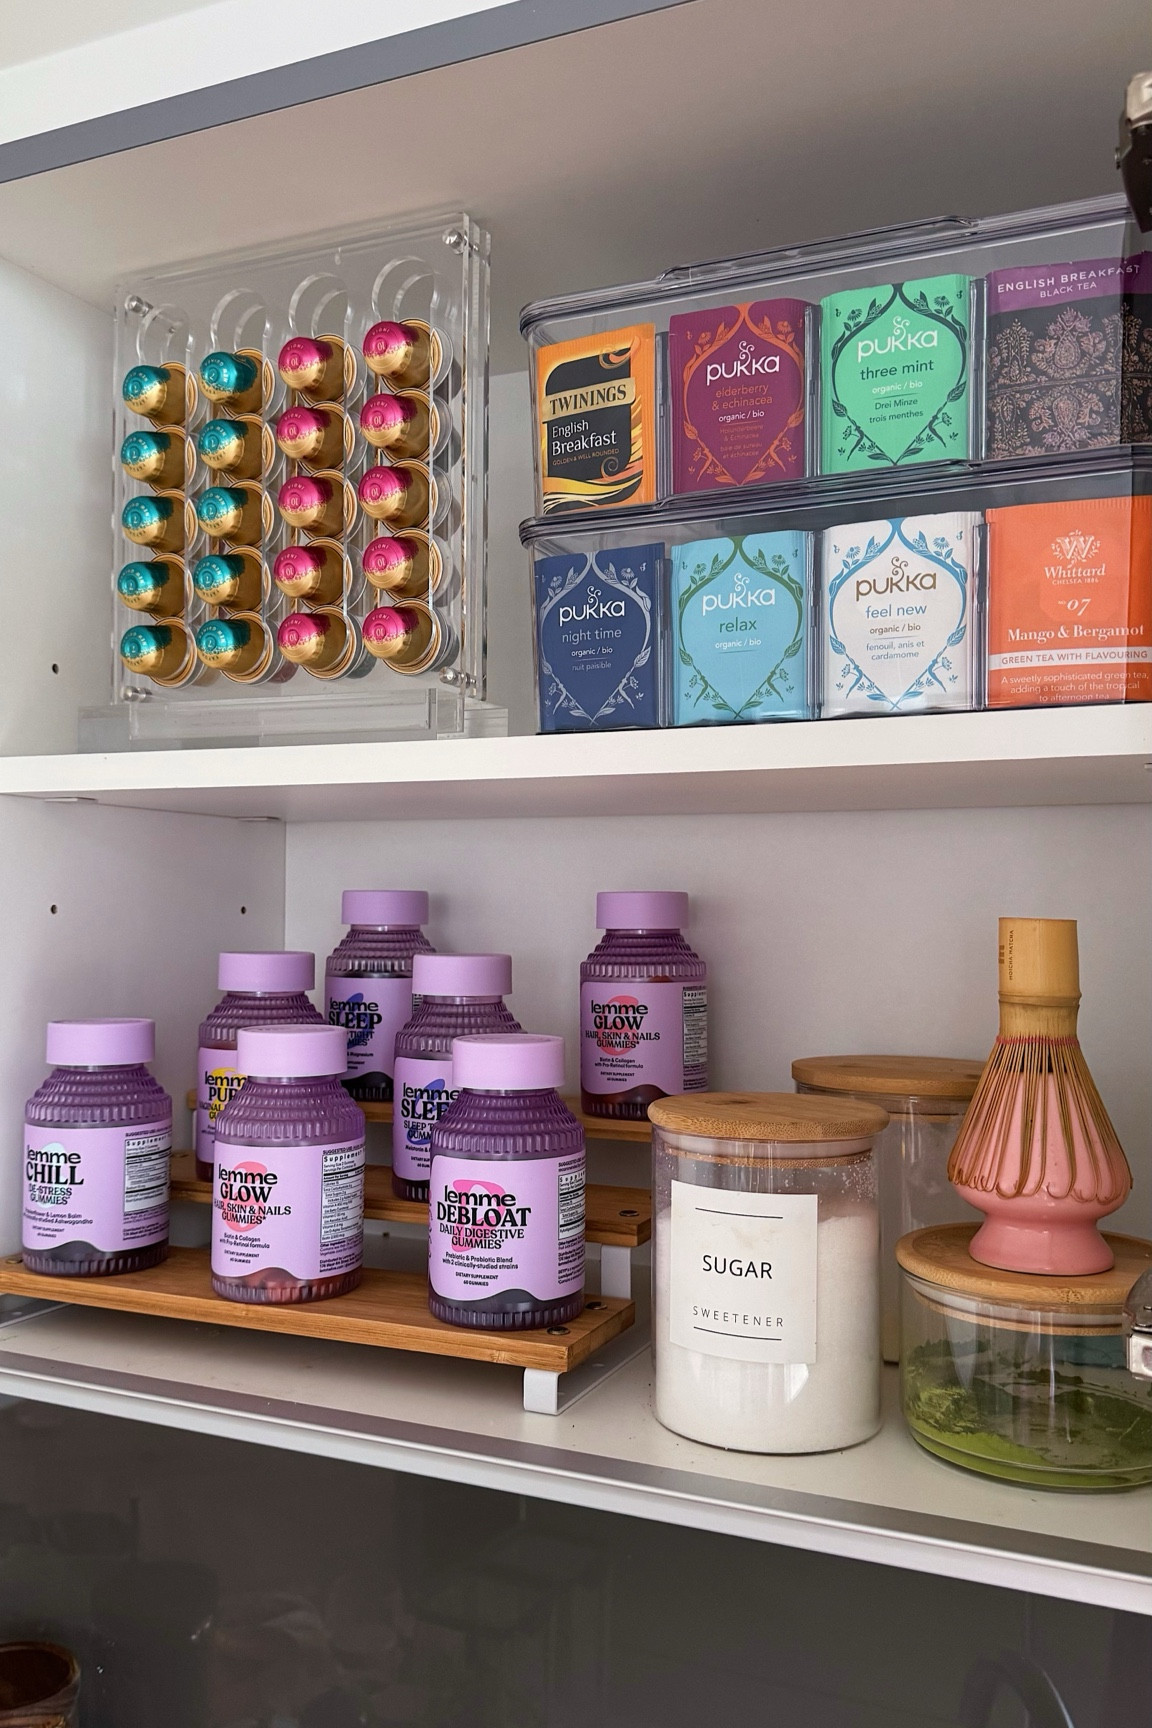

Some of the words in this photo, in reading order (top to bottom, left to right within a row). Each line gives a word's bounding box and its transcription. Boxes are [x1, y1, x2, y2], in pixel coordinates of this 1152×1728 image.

[997, 277, 1055, 293] ENGLISH
[1061, 265, 1140, 283] BREAKFAST
[1040, 286, 1073, 298] BLACK
[1077, 282, 1097, 290] TEA
[858, 316, 938, 363] pukka
[707, 341, 780, 386] pukka
[860, 367, 897, 380] three
[902, 360, 934, 374] mint
[716, 384, 768, 397] elderberry
[872, 383, 901, 394] organic
[910, 380, 922, 388] bio
[550, 384, 626, 414] TWININGS
[712, 401, 719, 411] &
[723, 396, 772, 409] echinacea
[875, 402, 891, 410] Drei
[894, 399, 918, 407] Minze
[719, 412, 745, 422] organic
[869, 415, 886, 423] trois
[889, 410, 923, 420] menthes
[553, 420, 588, 438] English
[553, 430, 616, 455] Breakfast
[592, 449, 619, 457] ROUNDED
[856, 556, 936, 601] pukka
[1044, 563, 1106, 579] Whittard
[702, 573, 775, 616] pukka
[560, 586, 624, 626] pukka
[865, 604, 891, 619] feel
[897, 605, 927, 616] new
[1067, 598, 1091, 616] 07
[720, 617, 757, 632] relax
[870, 625, 899, 635] organic
[902, 624, 906, 632] /
[908, 623, 921, 631] bio
[562, 629, 591, 645] night
[595, 628, 621, 639] time
[1008, 628, 1054, 643] Mango
[1058, 625, 1069, 638] &
[1074, 625, 1144, 641] Bergamot
[571, 648, 595, 657] organic
[715, 640, 742, 649] organic
[866, 642, 896, 651] fenouil,
[872, 652, 919, 660] cardamome
[1002, 655, 1033, 665] GREEN
[1036, 654, 1054, 662] TEA
[1057, 653, 1081, 661] WITH
[1086, 651, 1148, 660] FLAVOURING
[1001, 676, 1007, 684] A
[1010, 673, 1041, 684] sweetly
[1044, 672, 1102, 682] sophisticated
[1105, 673, 1130, 681] green
[1133, 671, 1148, 679] tea,
[1011, 685, 1040, 694] adding
[1051, 682, 1075, 691] touch
[1078, 682, 1087, 690] of
[1090, 681, 1103, 690] the
[330, 997, 378, 1011] lemme
[591, 1000, 648, 1014] lemme
[329, 1011, 382, 1029] SLEEP
[594, 1015, 644, 1030] GLOW
[632, 1032, 660, 1040] NAILS
[205, 1071, 247, 1087] lemm
[404, 1120, 426, 1130] SLEEP
[27, 1145, 81, 1164] lemme
[26, 1161, 84, 1185] CHILL
[219, 1164, 277, 1185] lemme
[220, 1182, 272, 1203] GLOW
[445, 1185, 516, 1207] lemme
[227, 1203, 246, 1214] SKIN
[248, 1206, 256, 1214] &
[258, 1206, 291, 1215] NAILS
[437, 1201, 531, 1227] DEBLOAT
[440, 1223, 463, 1236] DAILY
[465, 1228, 524, 1239] DIGESTIVE
[446, 1252, 465, 1260] Prebiotic
[702, 1255, 772, 1279] SUGAR
[693, 1306, 784, 1327] SWEETENER
